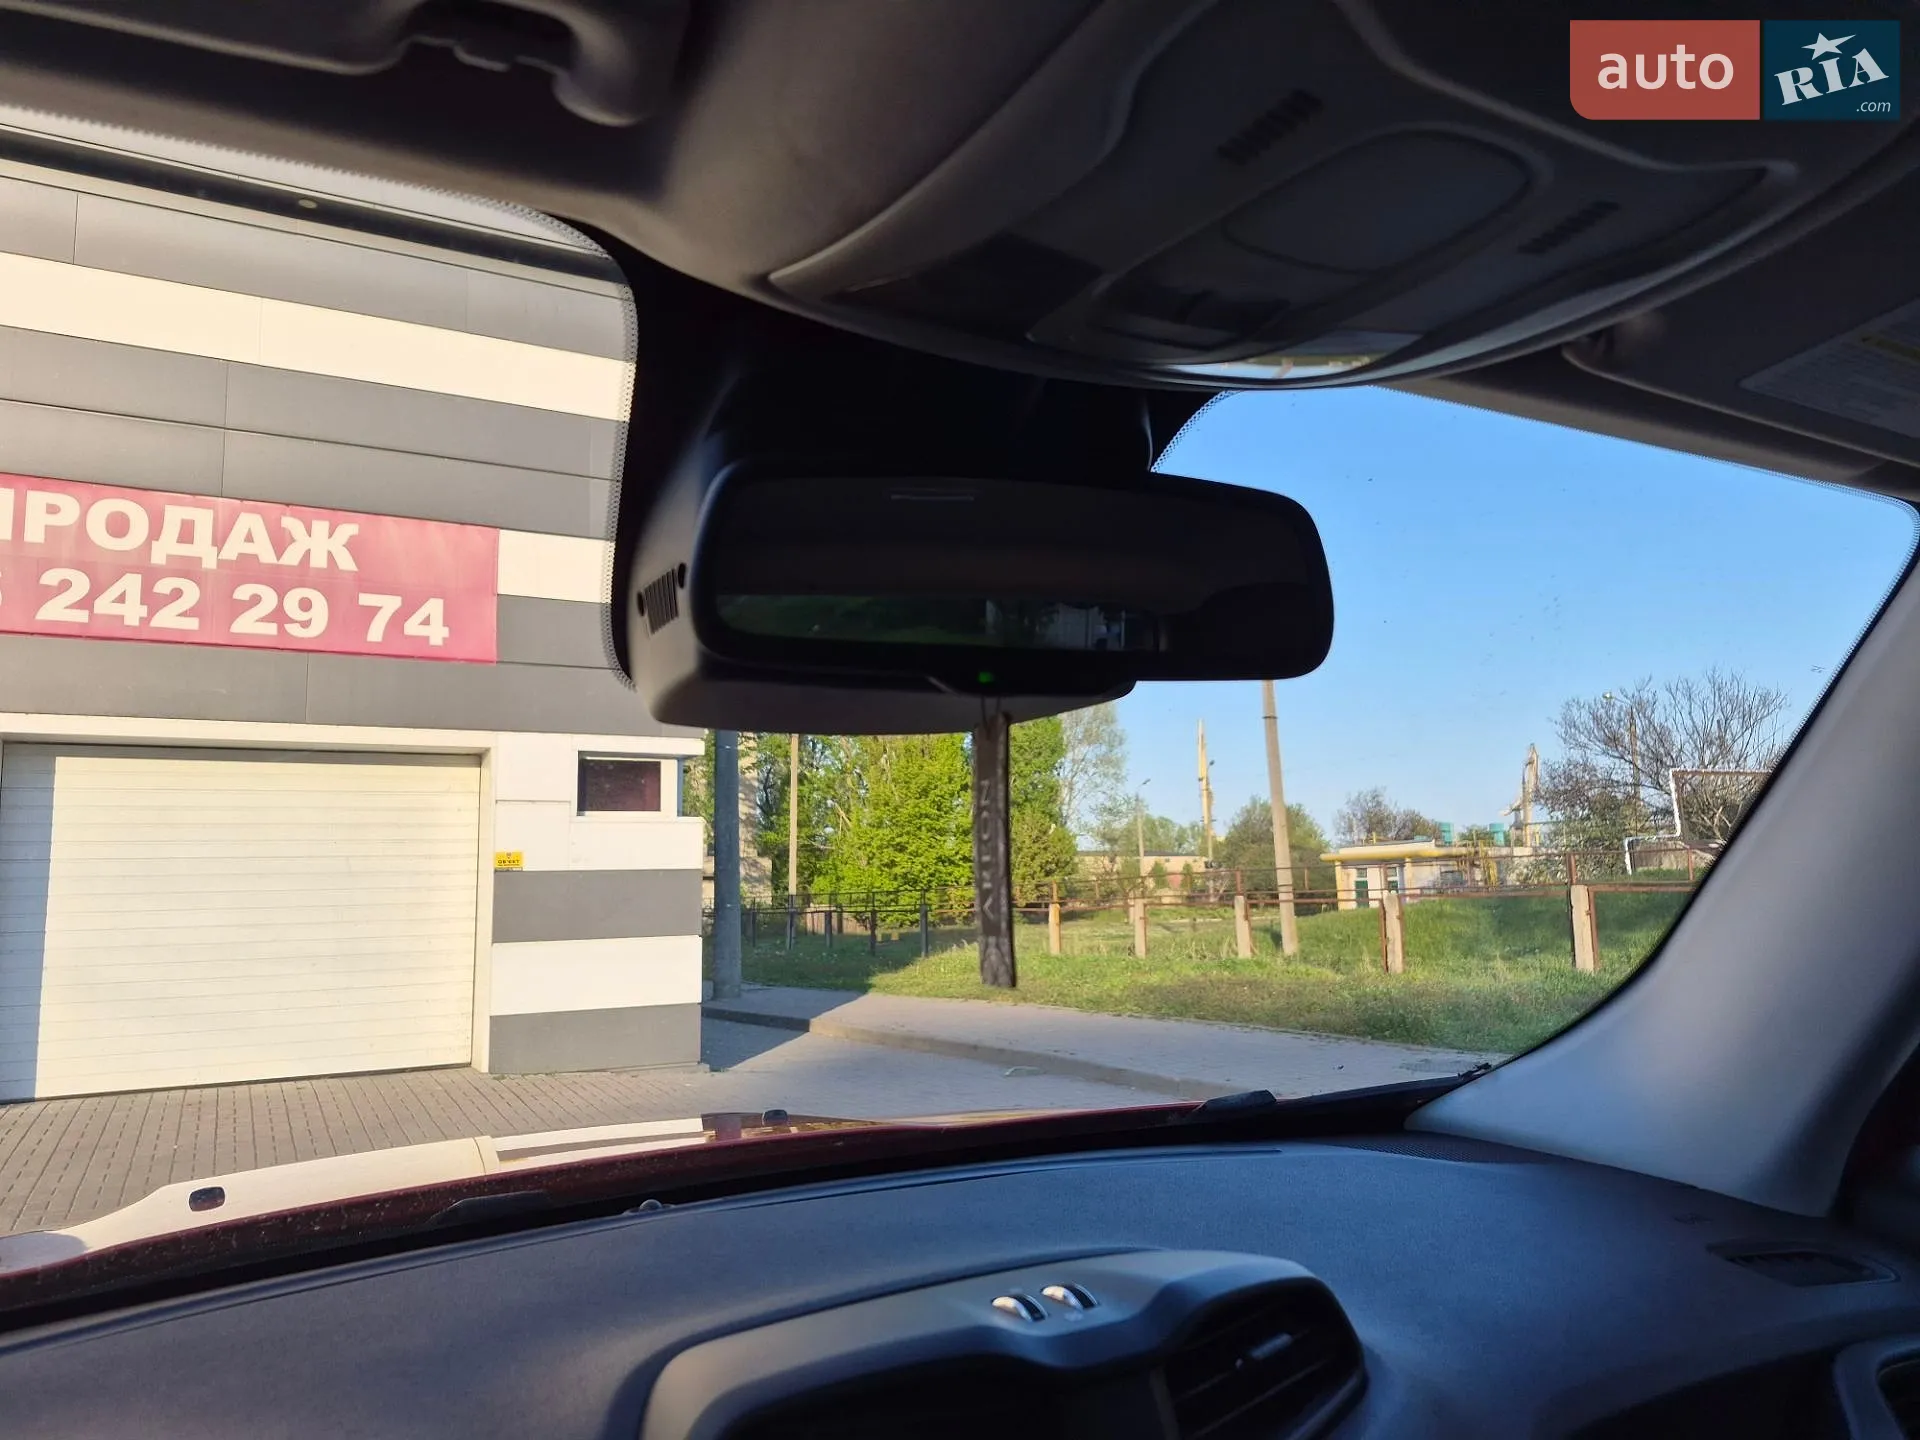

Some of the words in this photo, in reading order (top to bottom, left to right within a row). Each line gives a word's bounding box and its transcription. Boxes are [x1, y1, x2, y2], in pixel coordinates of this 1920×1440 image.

[35, 567, 201, 630] 242
[229, 583, 329, 639] 29
[358, 592, 450, 646] 74
